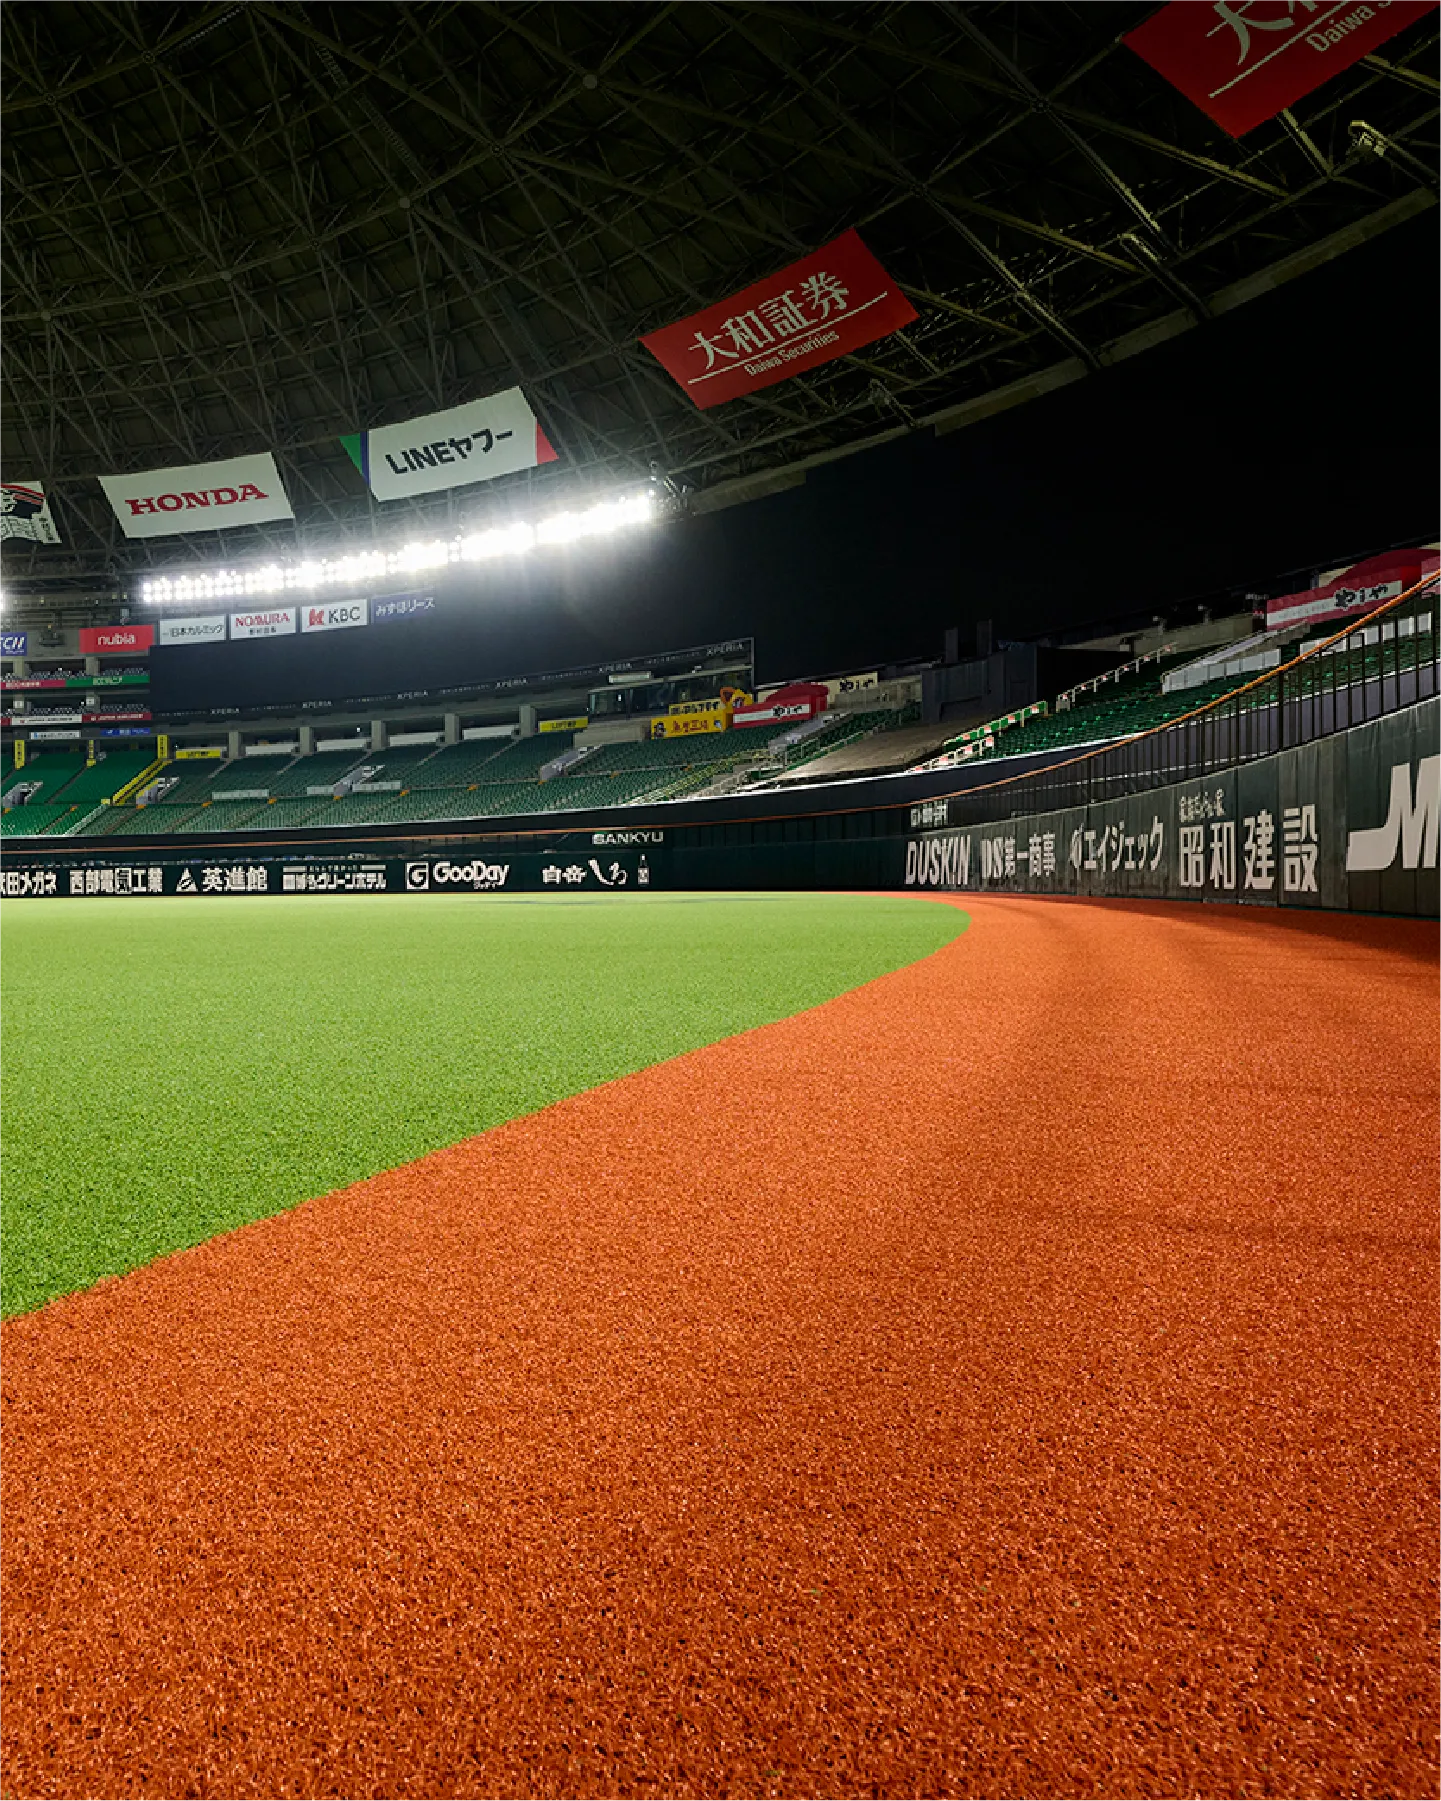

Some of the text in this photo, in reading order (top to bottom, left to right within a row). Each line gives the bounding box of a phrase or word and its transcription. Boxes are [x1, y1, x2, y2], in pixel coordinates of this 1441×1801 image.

[1305, 5, 1376, 52] Daiwa
[688, 271, 849, 370] 大和証券
[744, 330, 840, 377] Daiwa Securities
[385, 427, 514, 475] LINEヤフー
[124, 483, 270, 516] HONDA
[235, 612, 291, 628] NOMURA
[328, 606, 361, 624] KBC
[97, 632, 137, 646] nubia
[592, 831, 664, 845] SANKYU
[1179, 804, 1319, 892] 昭和建設
[202, 865, 268, 892] 英進館
[905, 835, 971, 885] DUSKIN
